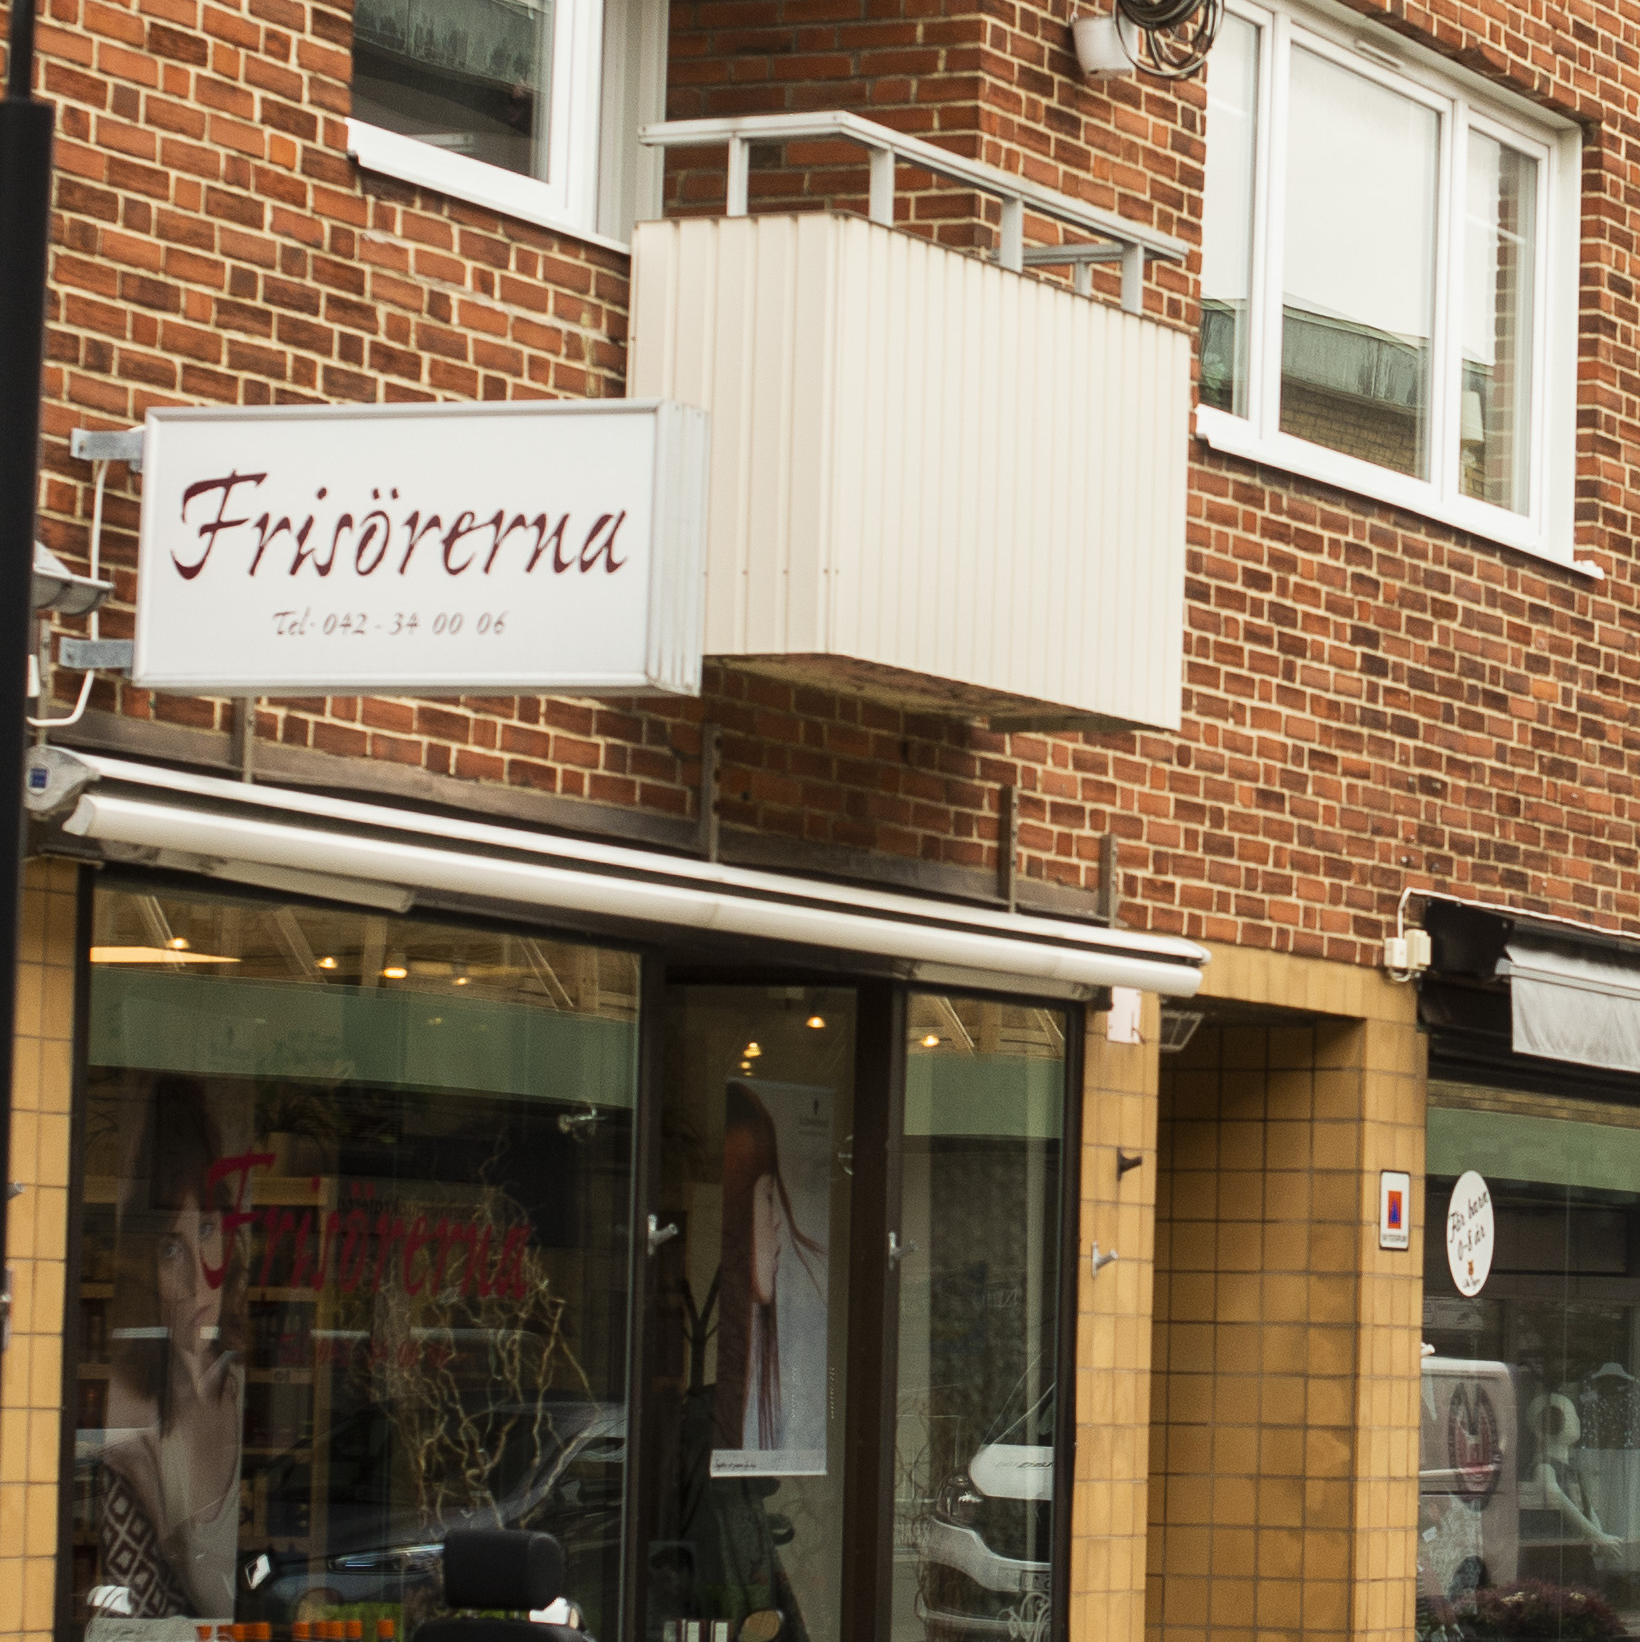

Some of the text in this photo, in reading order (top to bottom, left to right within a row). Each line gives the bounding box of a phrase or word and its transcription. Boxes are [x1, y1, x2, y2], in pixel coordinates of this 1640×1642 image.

[170, 469, 629, 582] Frisörerna
[432, 612, 465, 636] 00
[476, 609, 509, 636] 06
